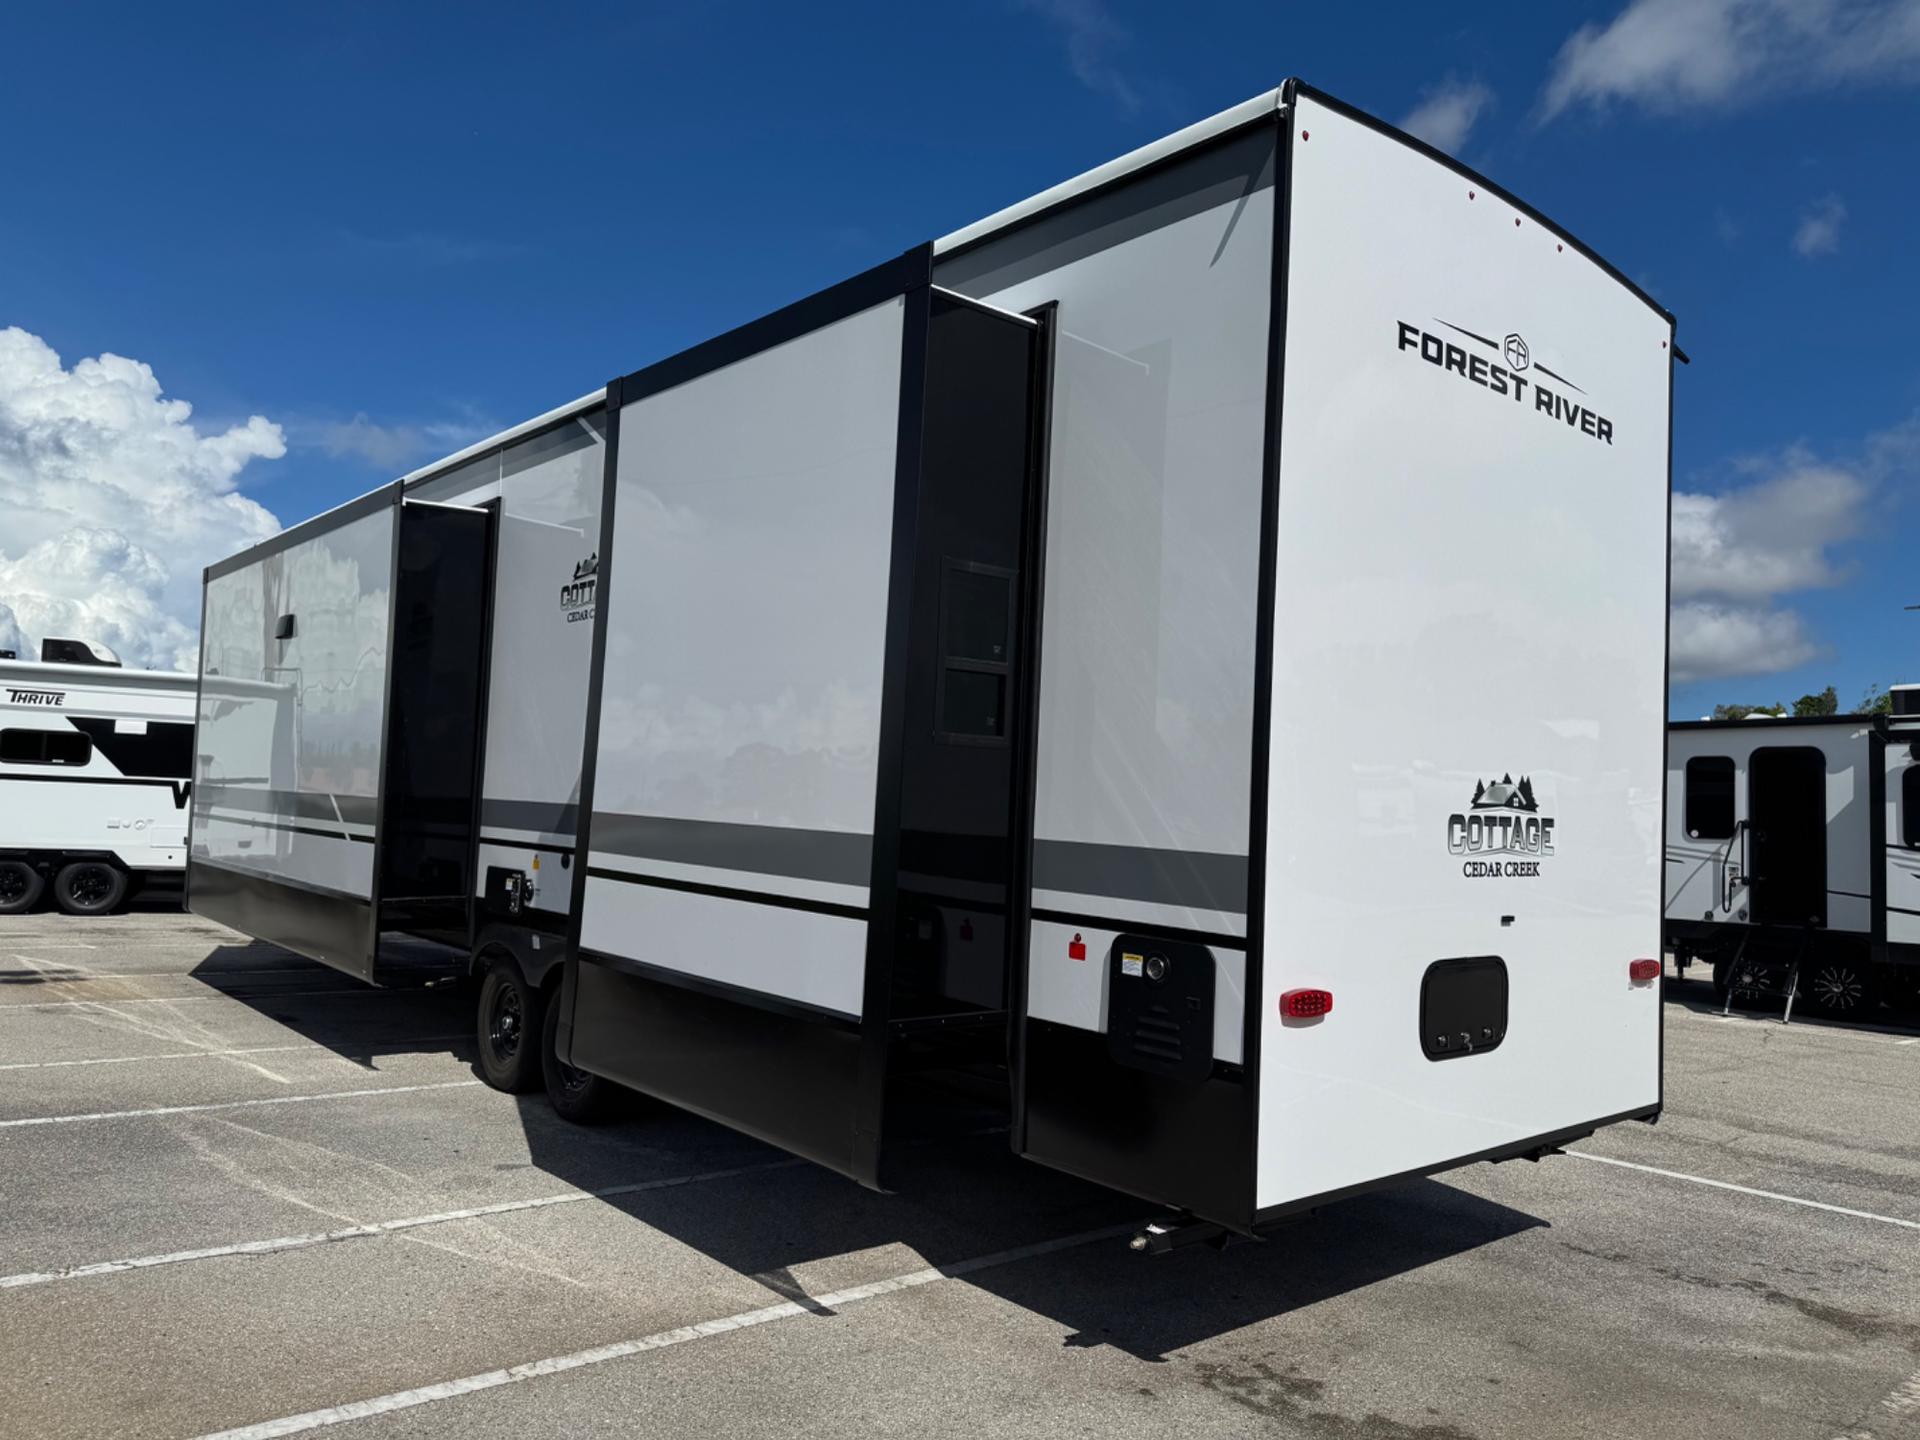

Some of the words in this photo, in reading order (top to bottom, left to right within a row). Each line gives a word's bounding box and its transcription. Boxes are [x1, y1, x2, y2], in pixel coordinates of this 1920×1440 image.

[1397, 320, 1528, 402] FOREST
[1535, 384, 1612, 446] RIVER
[561, 579, 597, 607] COTT
[6, 688, 66, 706] THRIVE
[1447, 813, 1555, 857] COTTAGE
[1463, 861, 1503, 878] CEDAR
[1504, 861, 1540, 877] CREEK
